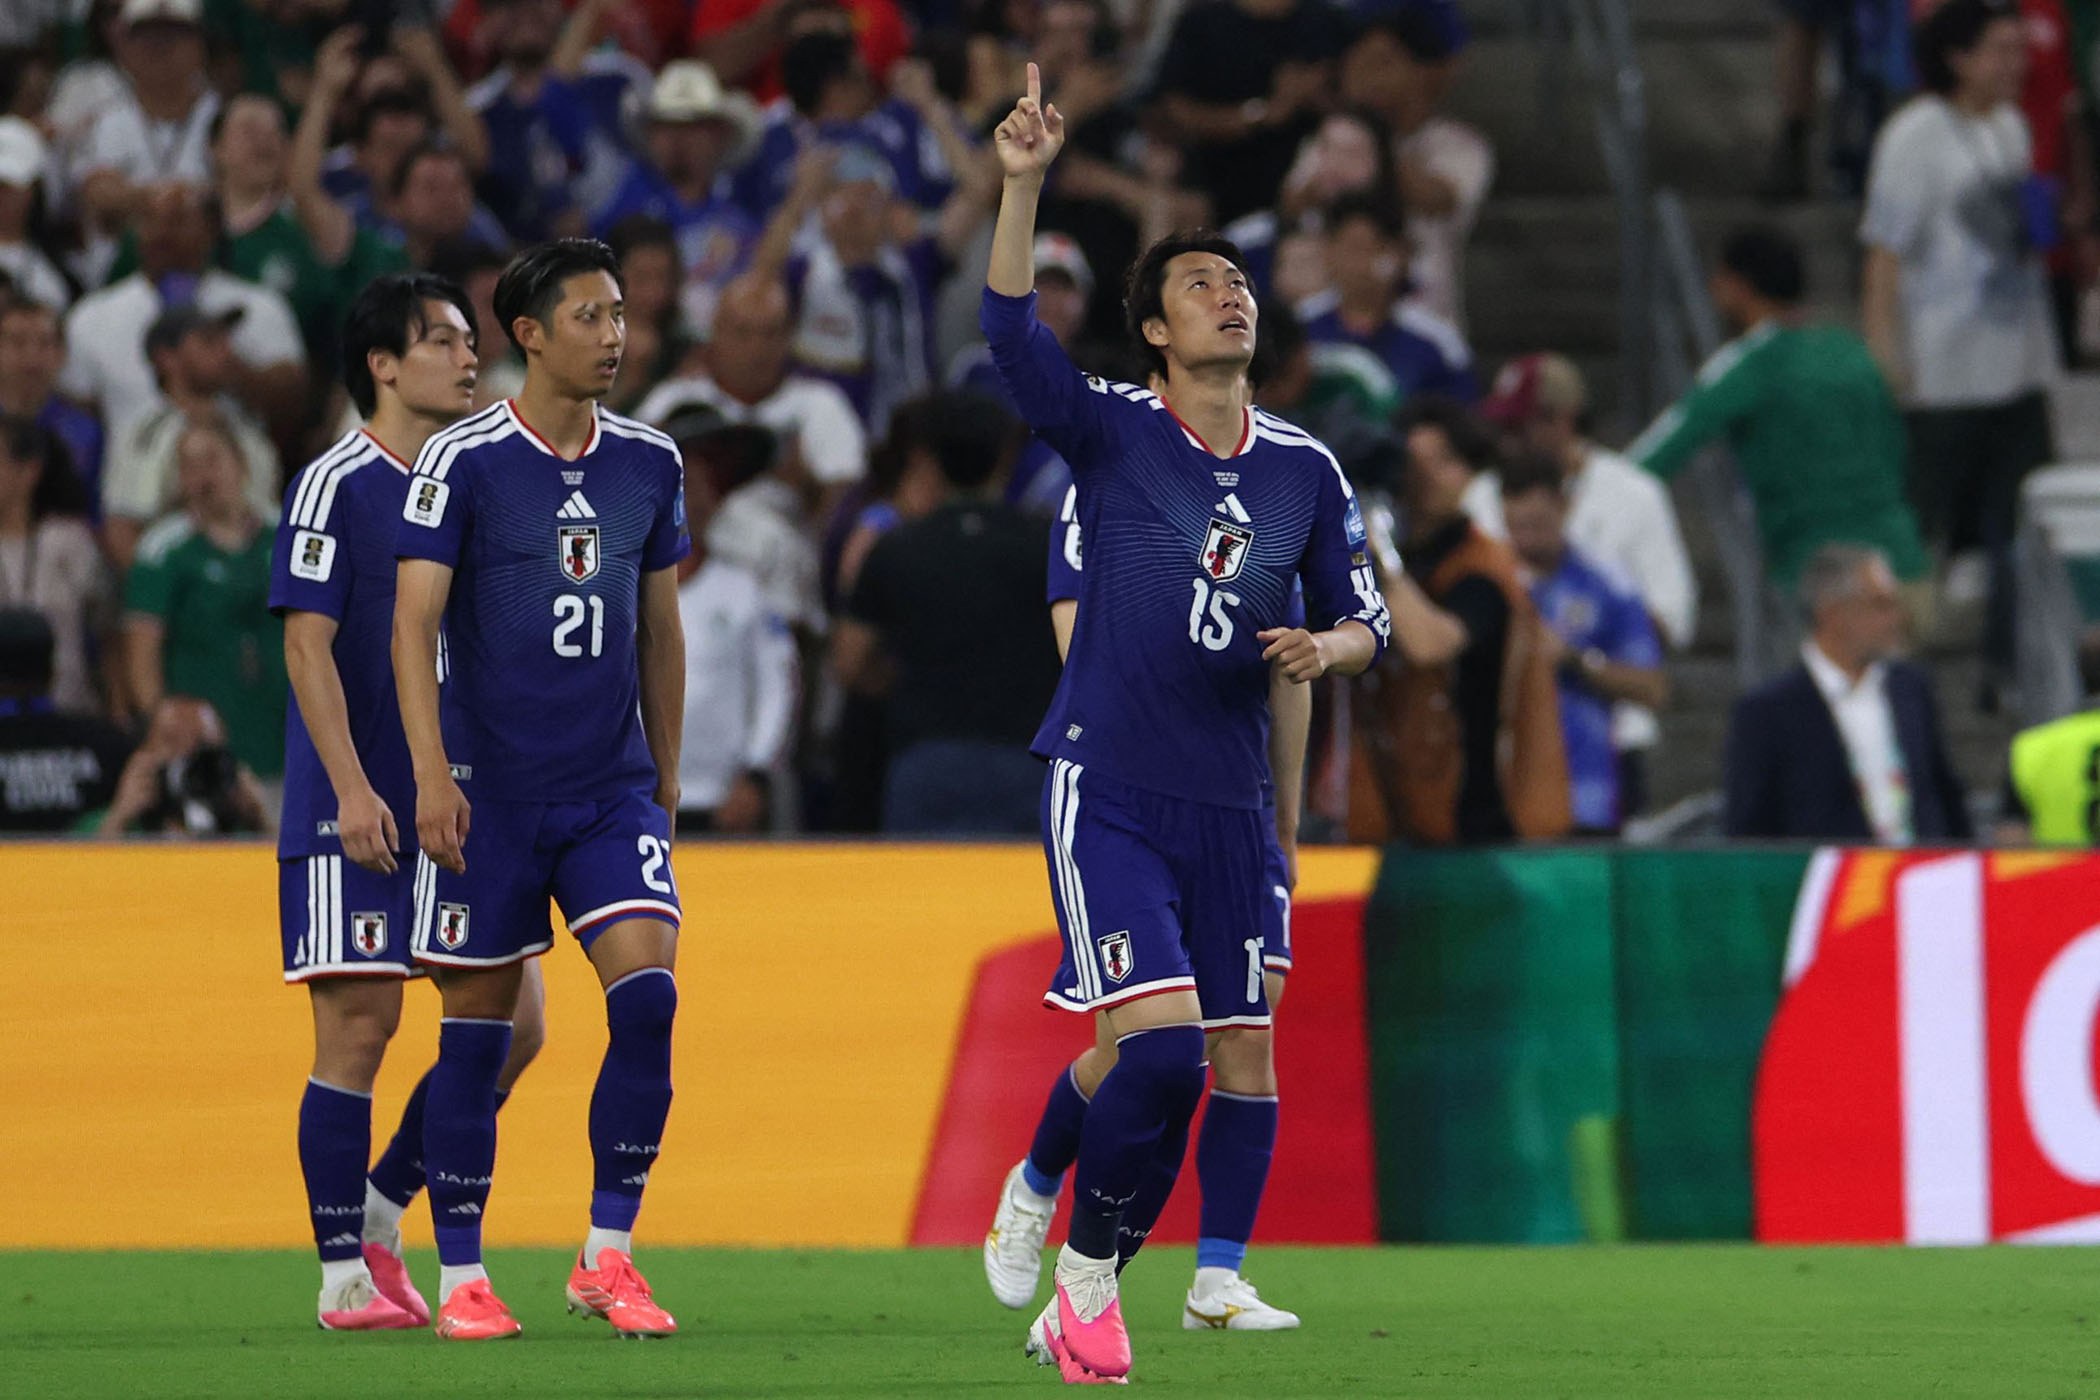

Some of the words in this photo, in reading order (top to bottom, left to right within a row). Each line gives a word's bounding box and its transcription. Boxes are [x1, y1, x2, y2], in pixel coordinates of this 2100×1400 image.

[553, 594, 604, 658] 21
[1189, 578, 1241, 651] 15
[1244, 936, 1264, 1004] 1
